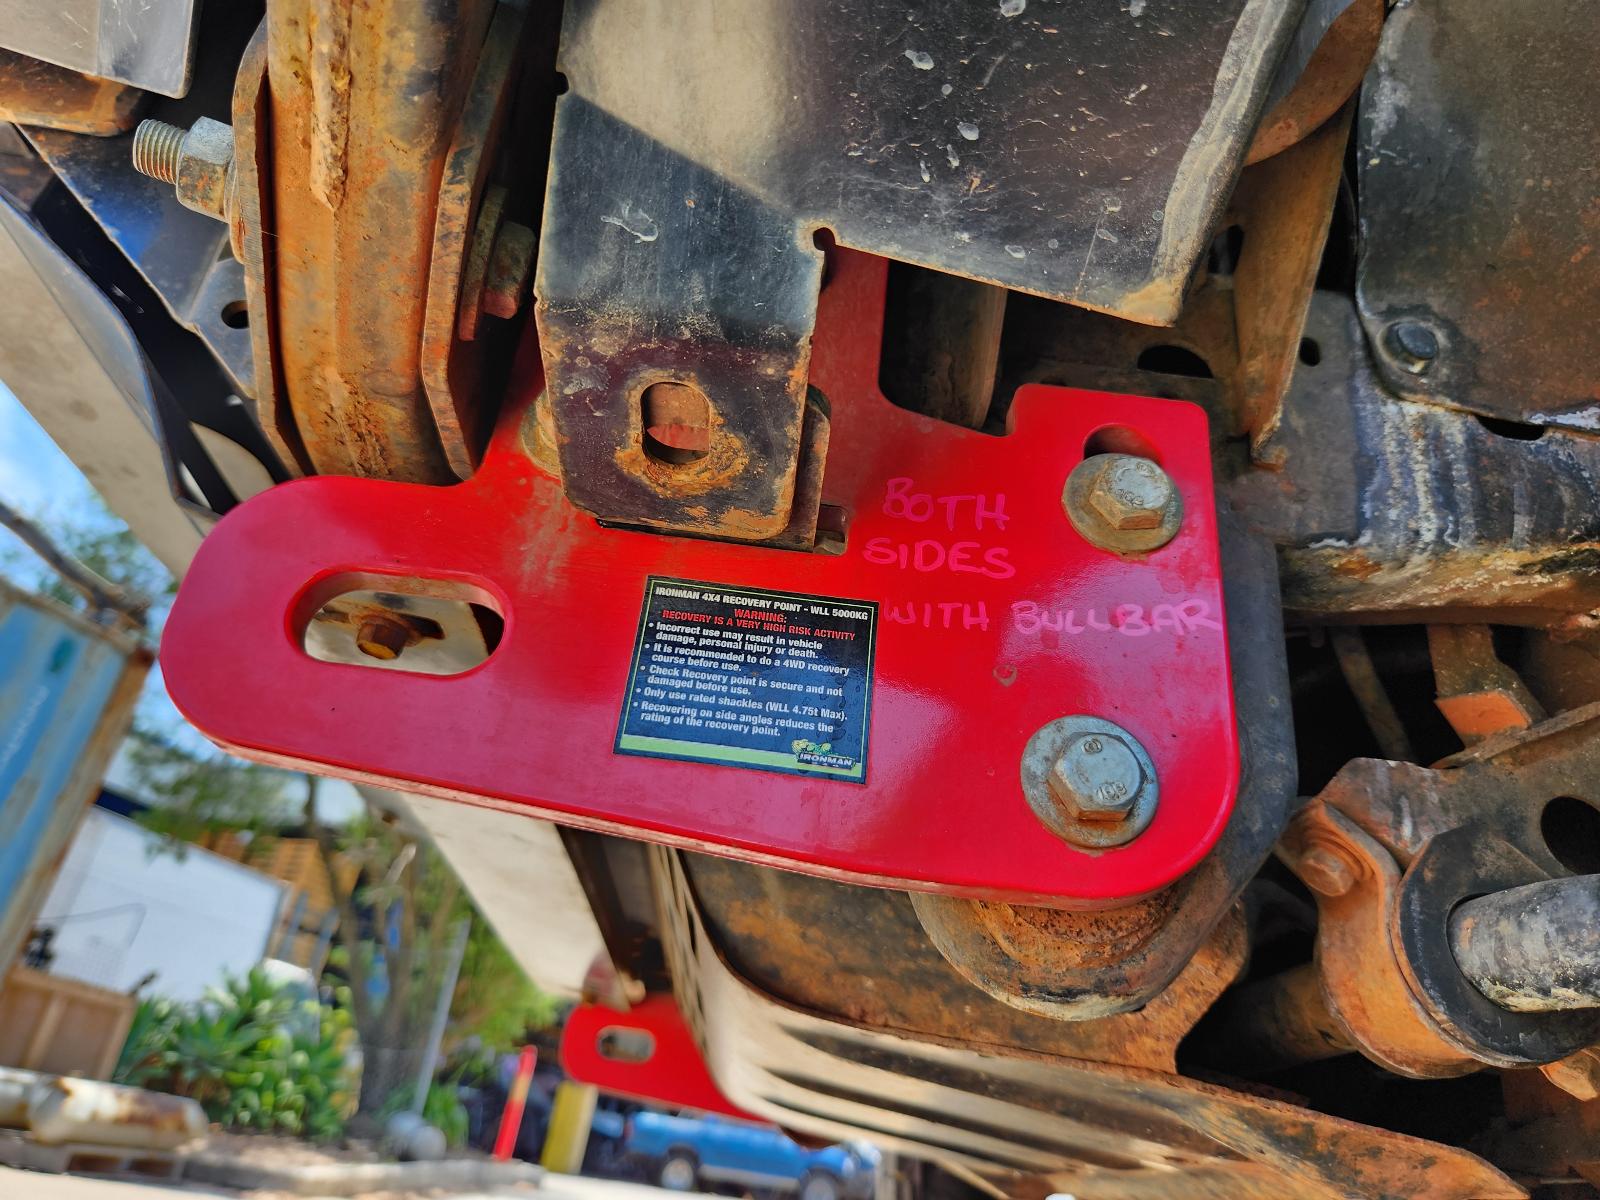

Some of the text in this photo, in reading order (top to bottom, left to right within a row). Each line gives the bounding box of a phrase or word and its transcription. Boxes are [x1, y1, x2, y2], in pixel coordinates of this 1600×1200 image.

[883, 477, 1009, 531] BOTH
[863, 537, 1016, 579] SIDES
[655, 587, 700, 600] IRONMAN
[702, 593, 721, 603] 4X4
[722, 595, 772, 609] RECOVERY
[774, 601, 802, 612] POINT
[810, 605, 830, 616] WLL
[832, 608, 868, 620] 5000KG
[734, 609, 787, 623] WARNING:
[883, 601, 989, 631] WITH
[656, 622, 823, 650] Incorrect use may result in vehicle
[661, 609, 856, 641] RECOVERY IS A VERY HIGH RISK ACTIVITY
[653, 642, 850, 677] It is recommended to do a 4WD recovery
[655, 631, 819, 659] damage, personal injury or death.
[651, 653, 742, 672] course before use.
[647, 675, 693, 688] damaged
[695, 680, 728, 693] before
[649, 664, 843, 697] Check Recovery point is secure and not
[640, 700, 834, 733] Recovering on side angles reduces the
[643, 686, 848, 722] Only use rated shackles (WLL 4.75t Max).
[640, 711, 781, 737] rating of the recovery point.
[799, 753, 853, 766] IRONMAN
